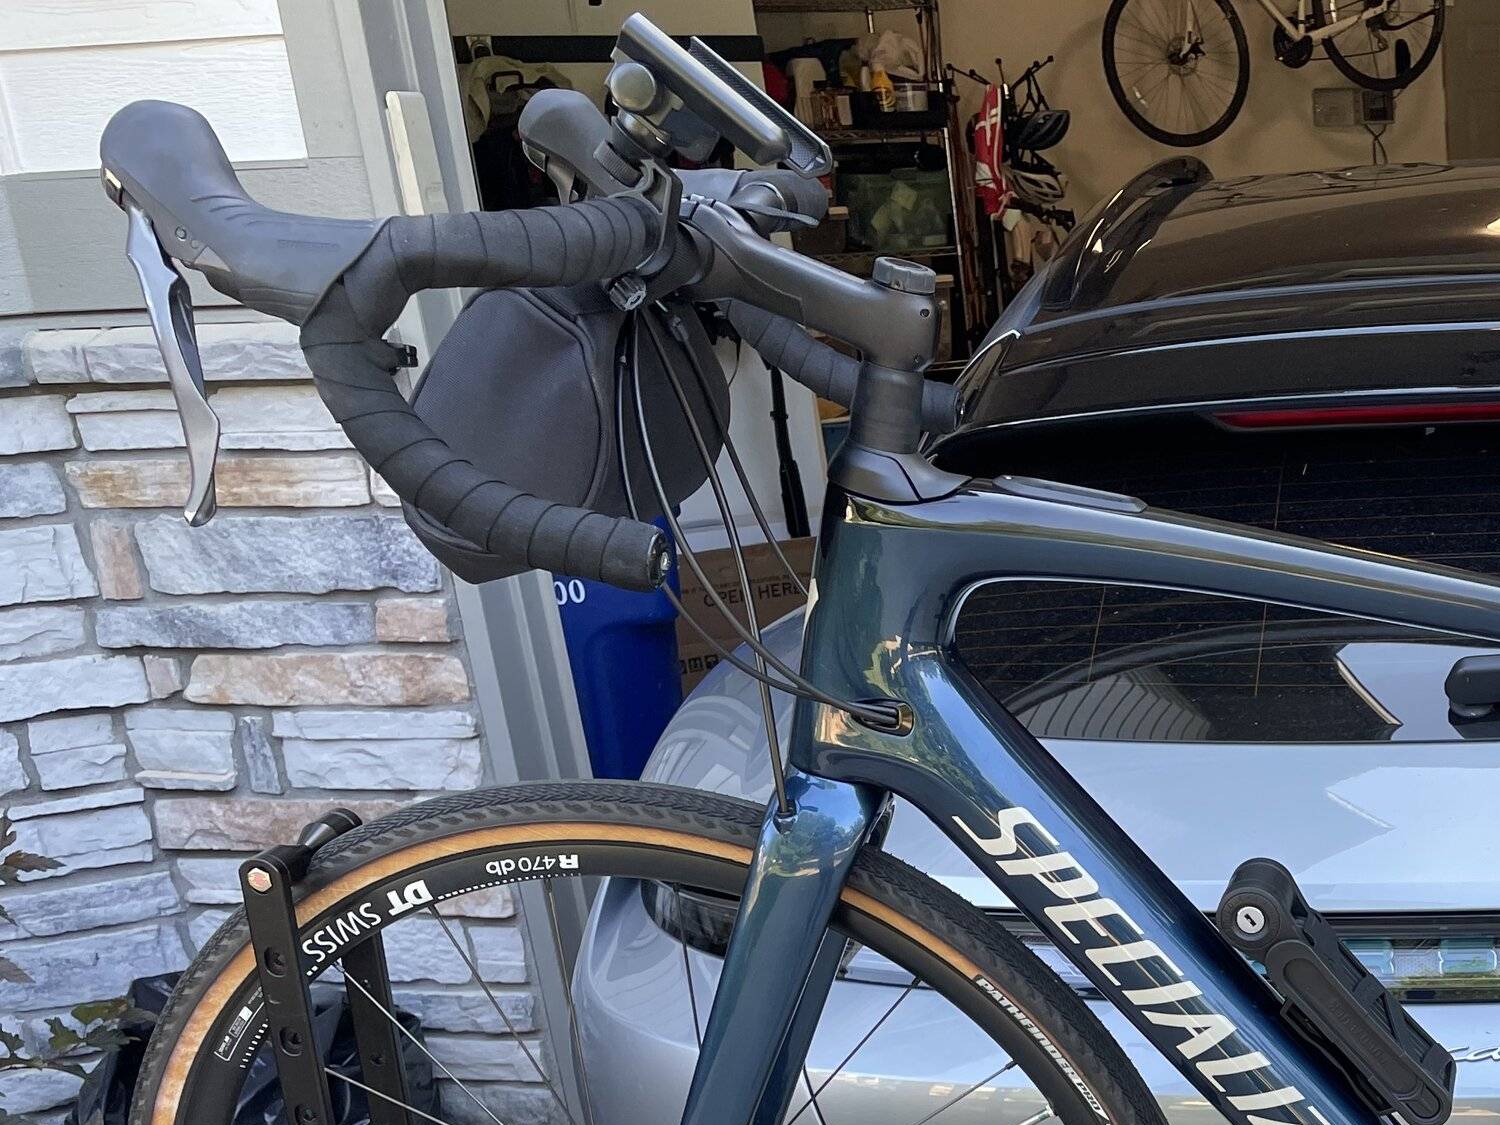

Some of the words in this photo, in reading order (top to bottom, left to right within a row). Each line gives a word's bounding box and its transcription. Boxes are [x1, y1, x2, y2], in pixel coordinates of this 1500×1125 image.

[386, 879, 434, 916] DT
[302, 902, 382, 963] SWISS
[976, 977, 1077, 1086] PATHFINDER
[1077, 1081, 1101, 1113] PRO
